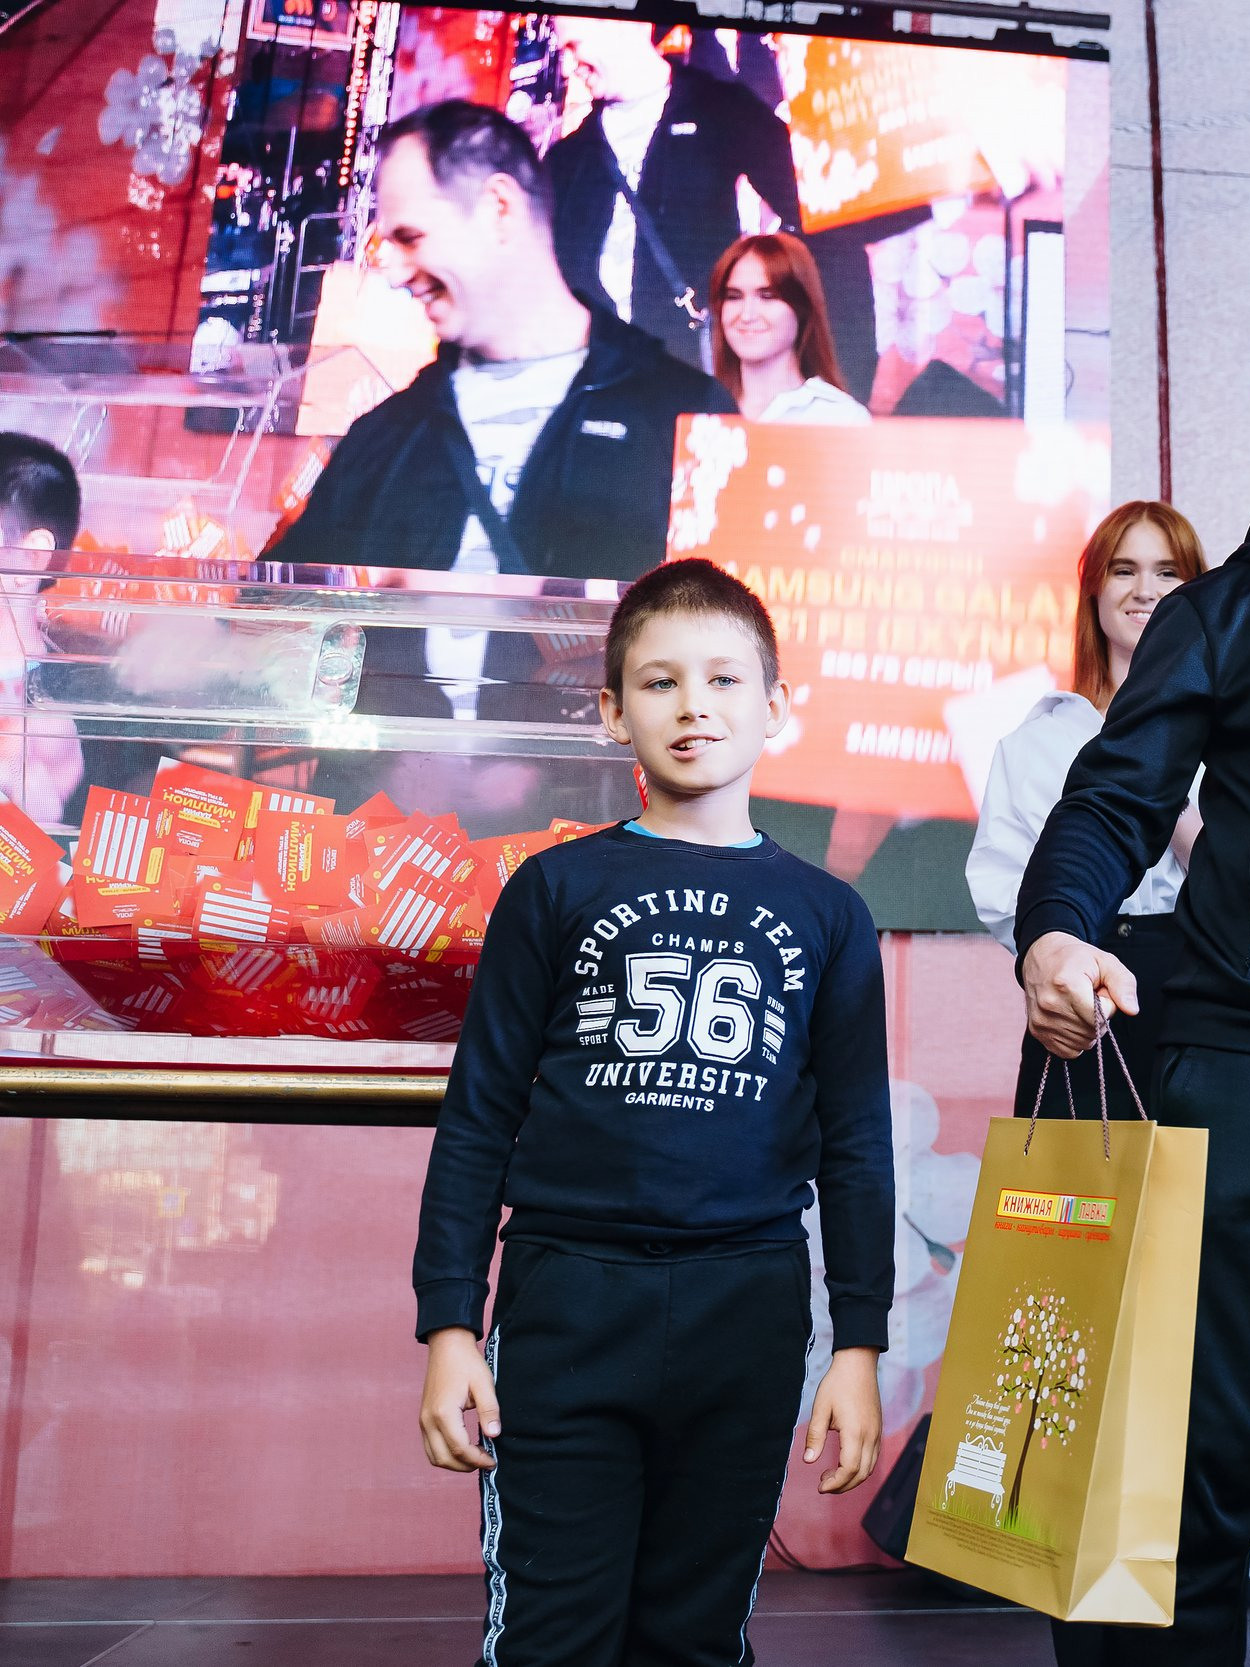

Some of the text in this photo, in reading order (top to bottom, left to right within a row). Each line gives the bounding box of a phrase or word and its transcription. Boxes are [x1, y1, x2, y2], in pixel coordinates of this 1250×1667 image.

[163, 792, 236, 819] МИЛЛИОН
[286, 821, 300, 892] МИЛЛИОН
[574, 888, 806, 992] SPORTING TEAM
[652, 933, 745, 954] CHAMPS
[582, 984, 615, 996] MADE
[615, 952, 762, 1065] 56
[579, 1033, 608, 1046] SPORT
[762, 1046, 777, 1065] TEAM
[585, 1062, 768, 1102] UNIVERSITY
[624, 1092, 715, 1112] GARMENTS
[1003, 1195, 1053, 1216] КНИЖНАЯ
